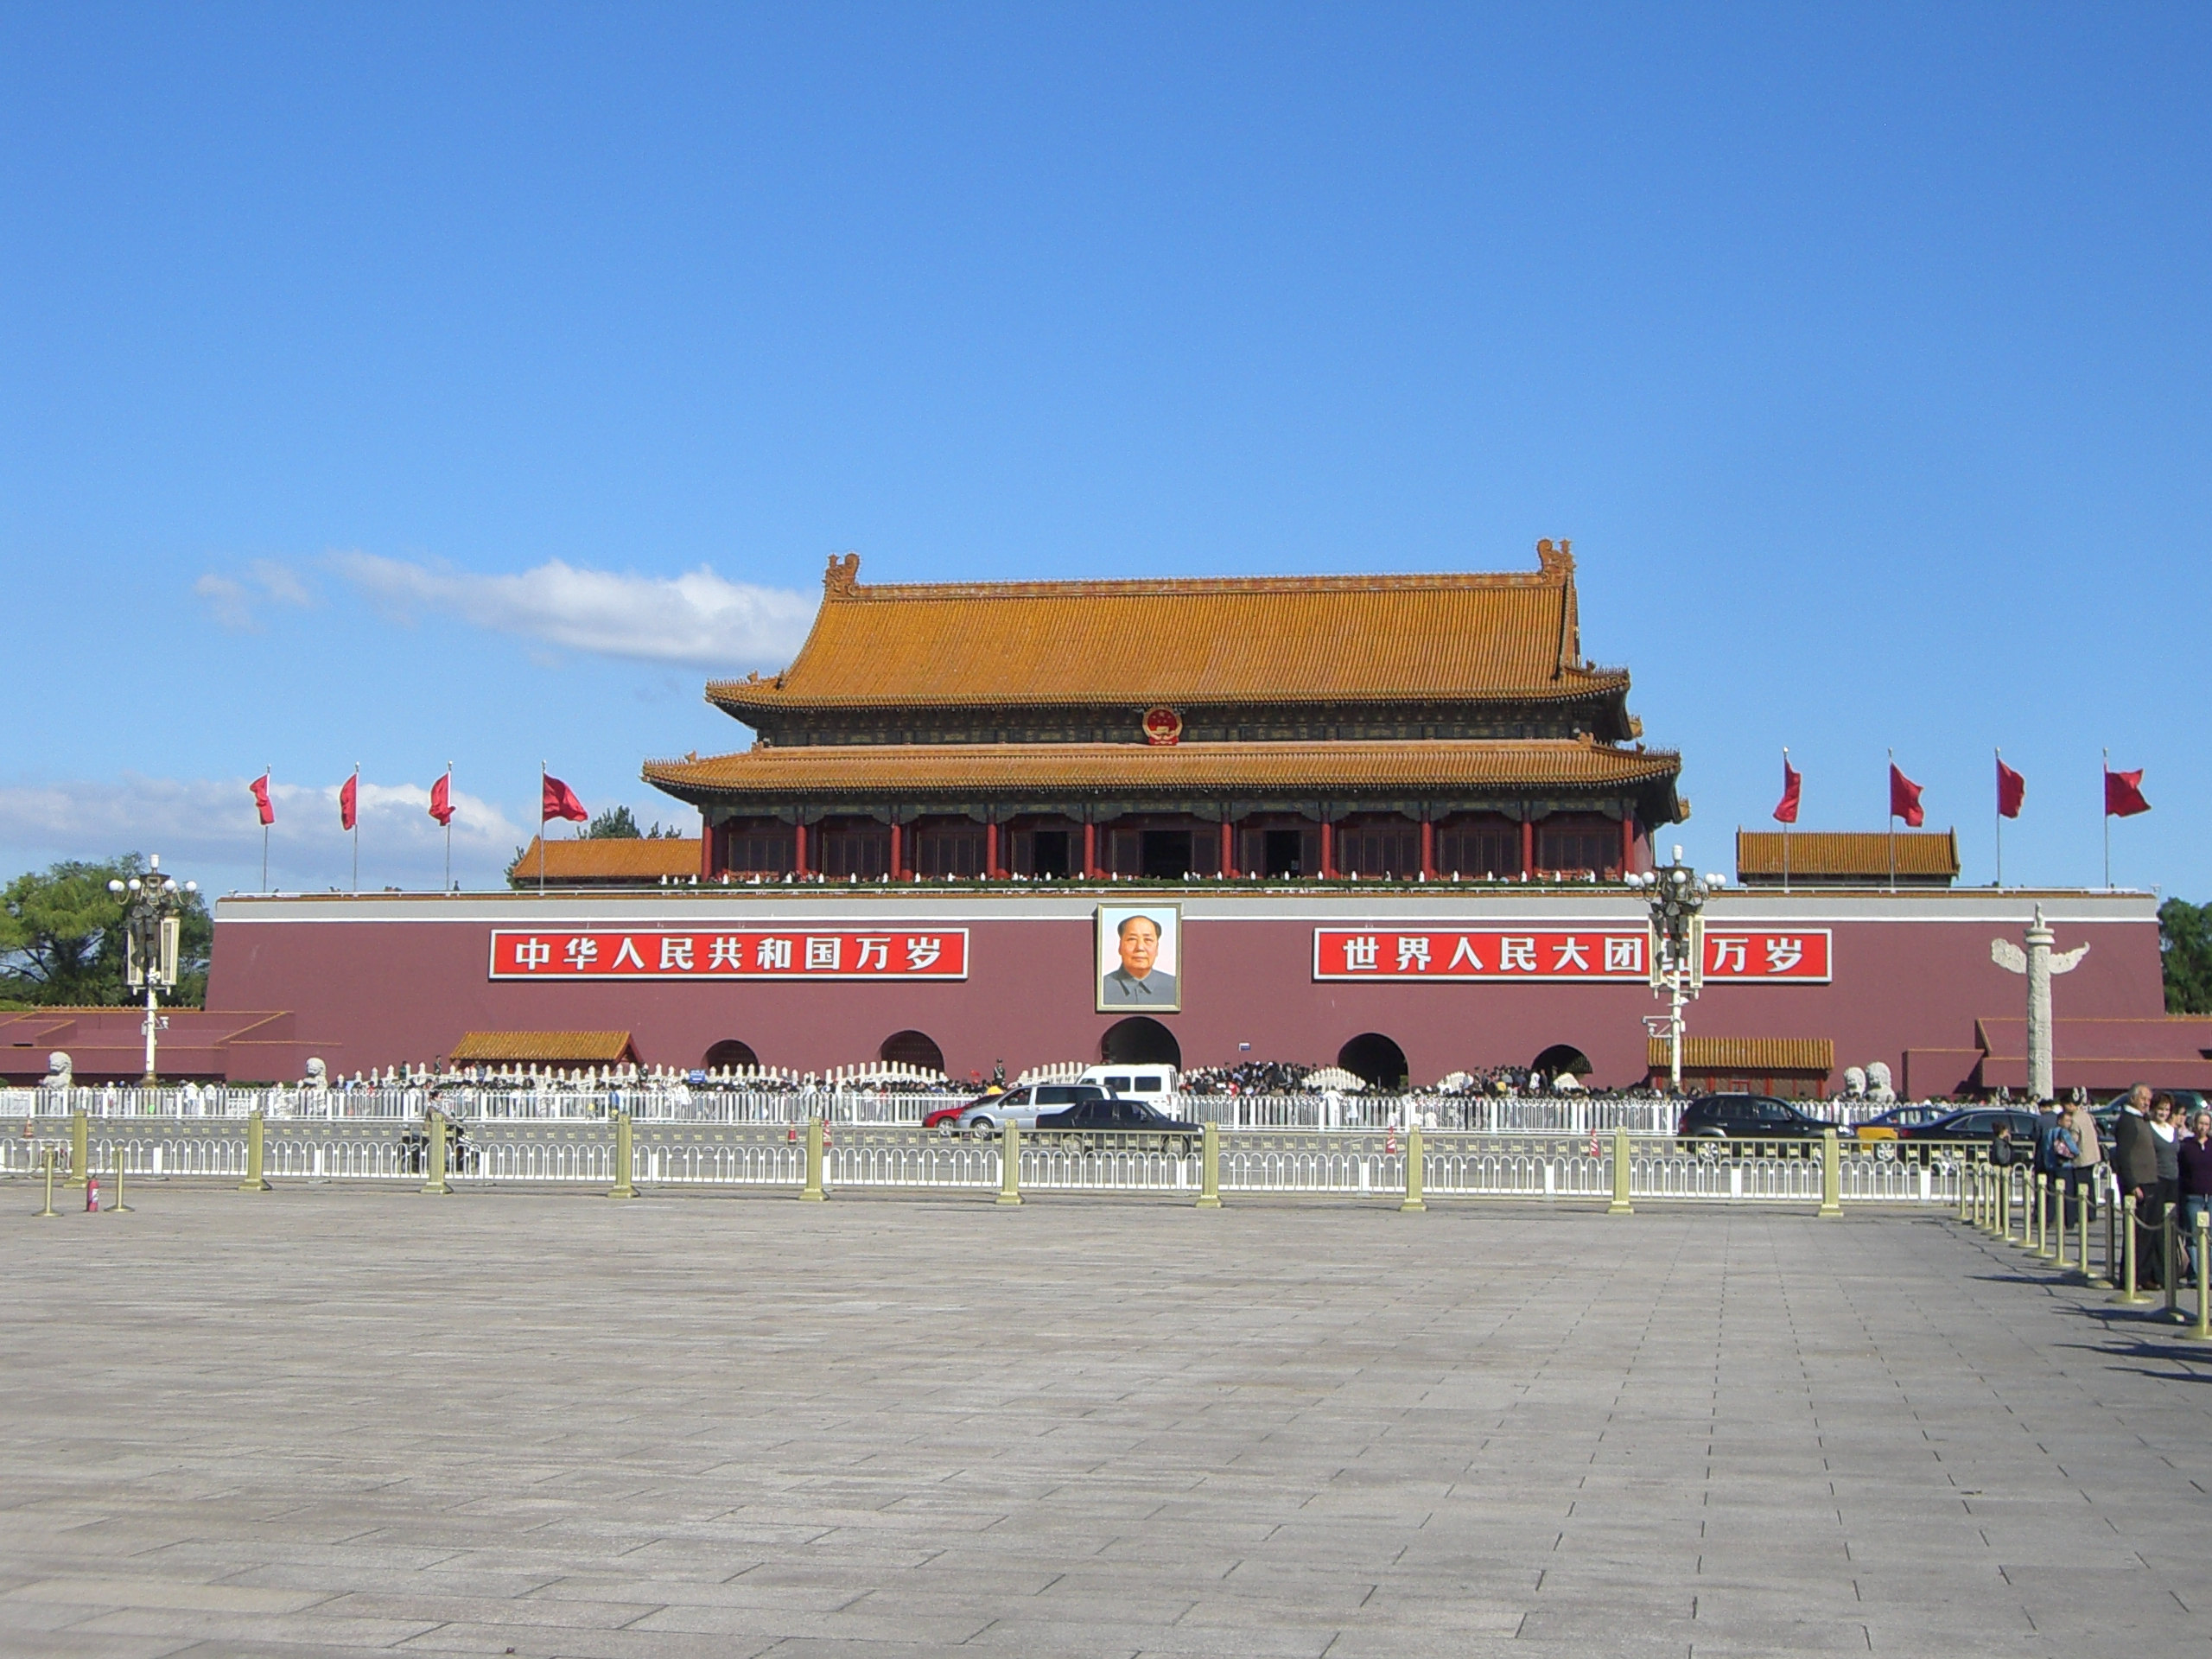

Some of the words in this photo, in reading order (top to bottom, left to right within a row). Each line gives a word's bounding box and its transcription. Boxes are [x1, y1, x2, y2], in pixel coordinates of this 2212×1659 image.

[515, 937, 942, 970] 中华人民共和国万岁
